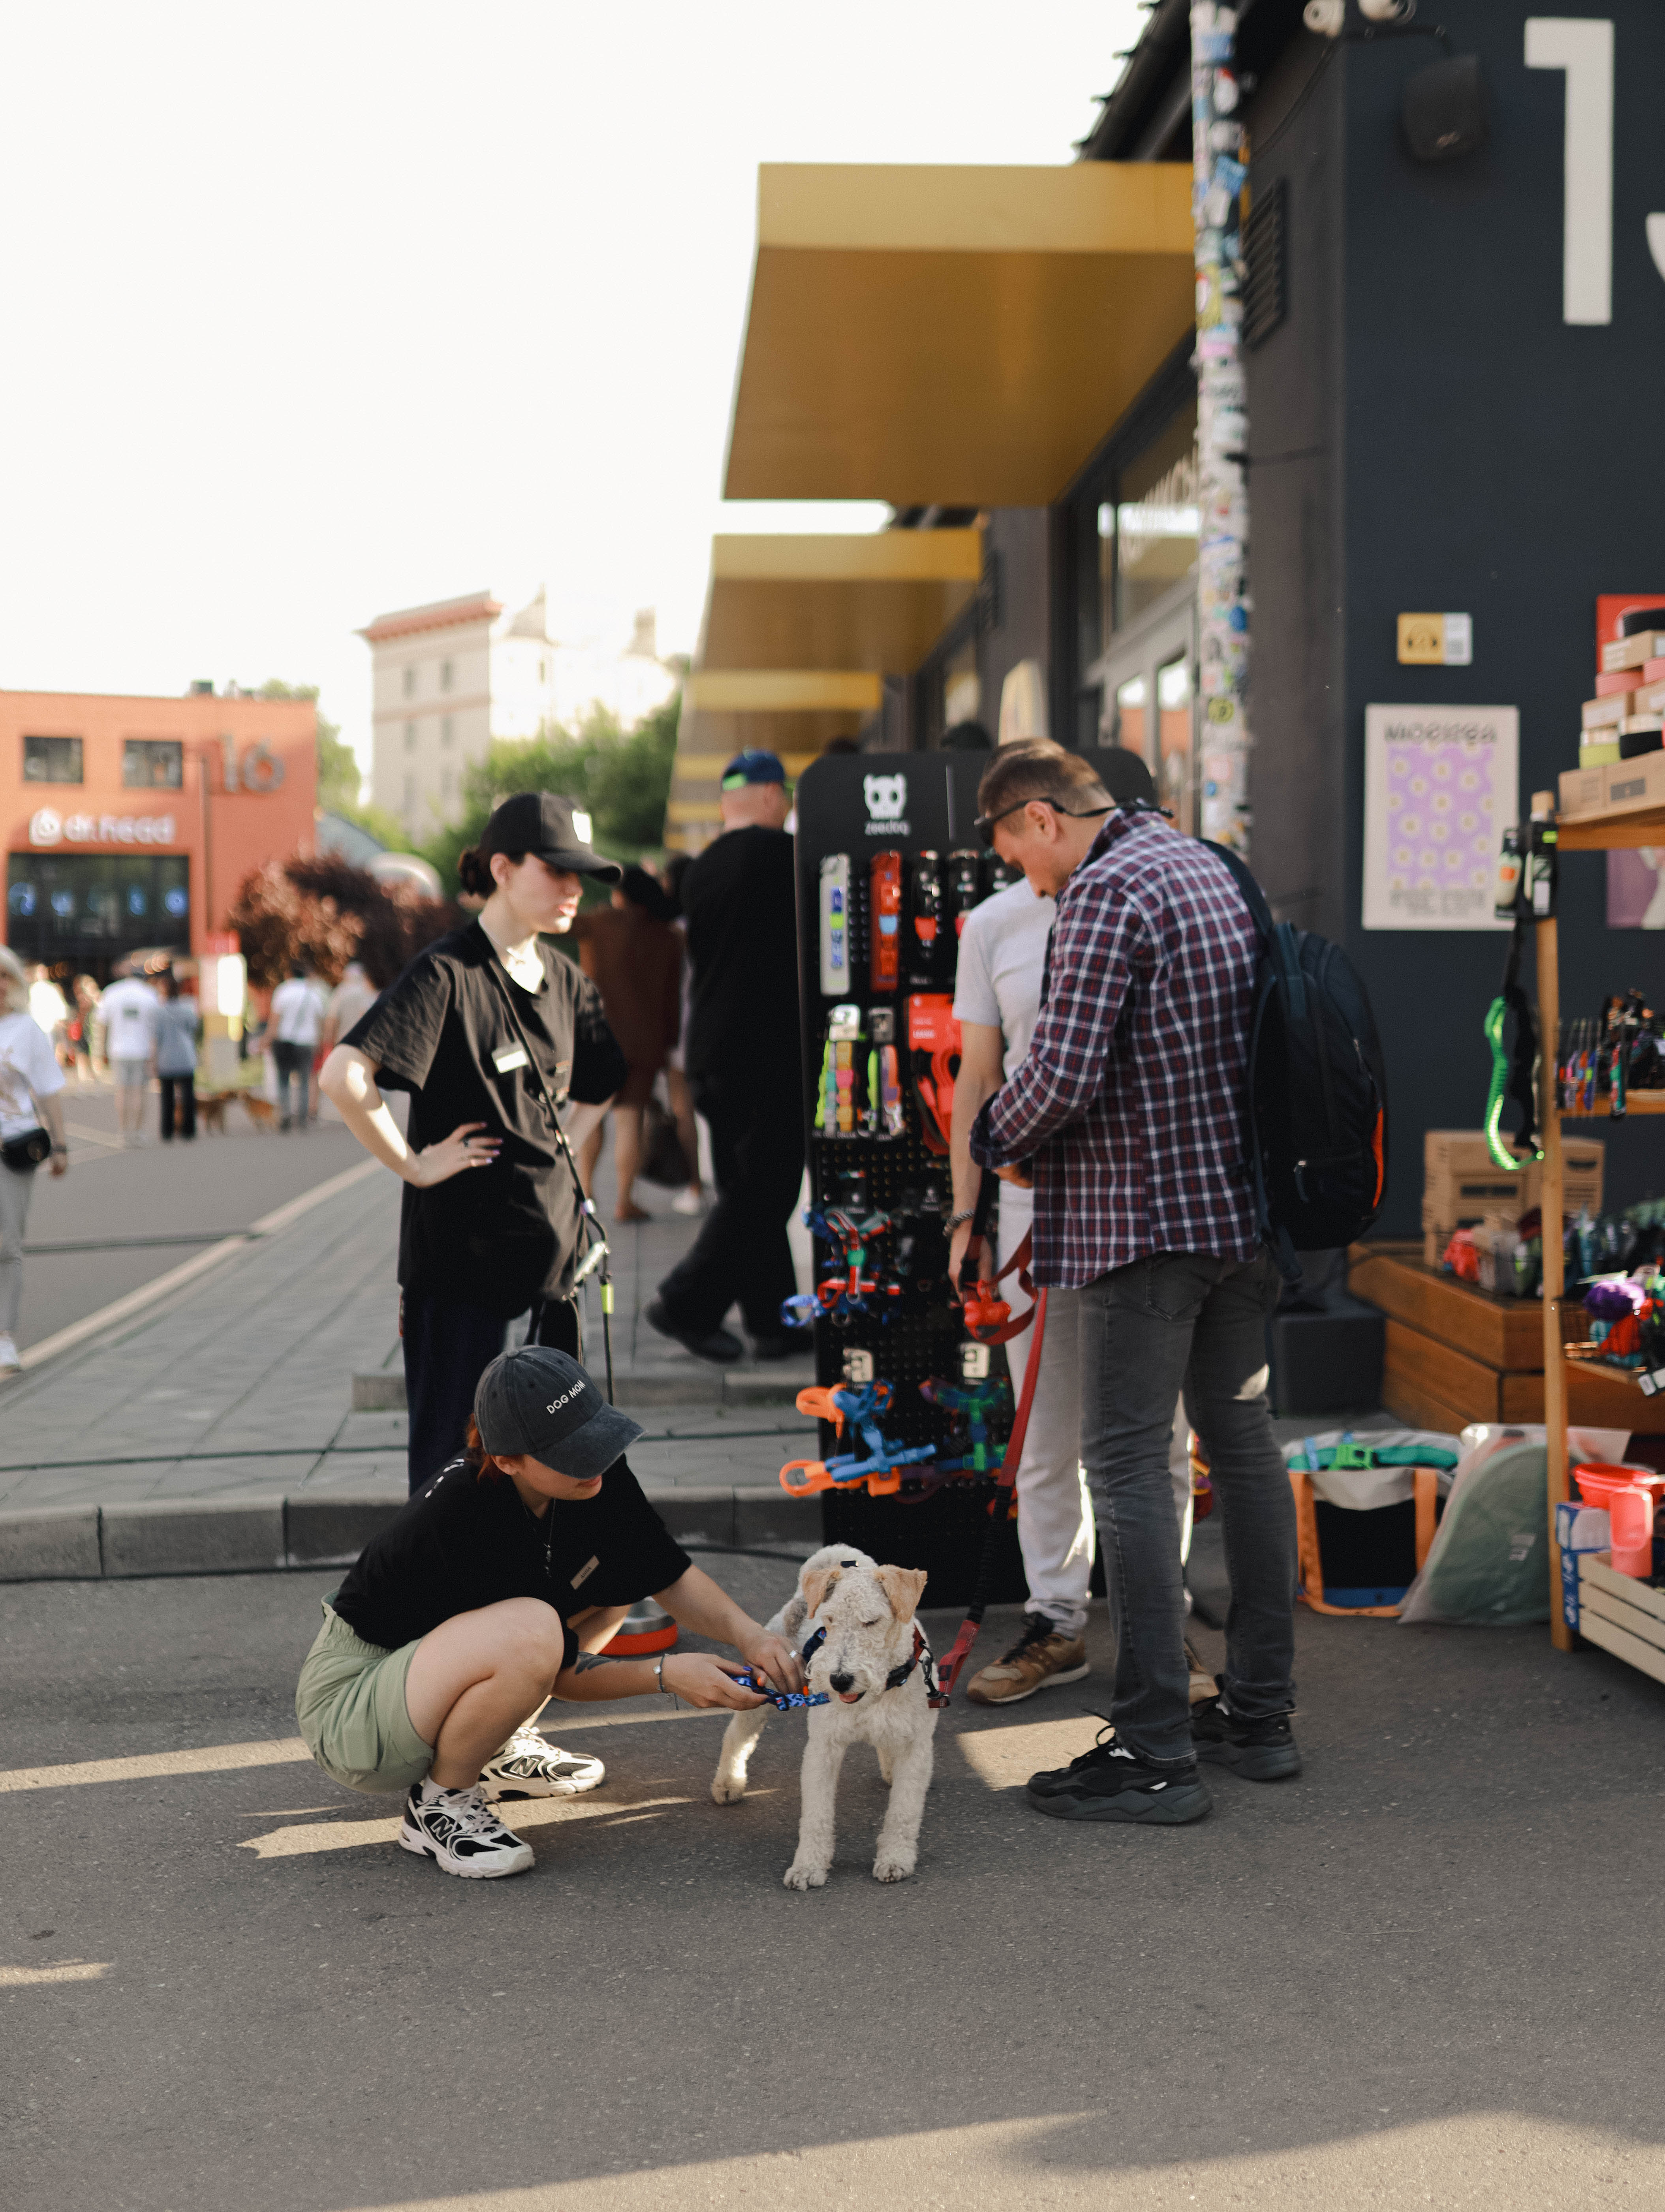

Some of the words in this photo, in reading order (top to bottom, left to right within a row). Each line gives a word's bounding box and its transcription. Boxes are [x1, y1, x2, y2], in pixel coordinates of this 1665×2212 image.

[1524, 17, 1665, 326] 1
[218, 733, 286, 793] 16
[546, 1394, 569, 1414] DOG
[568, 1379, 586, 1398] MOM
[509, 1756, 540, 1777] N
[430, 1815, 454, 1841] N
